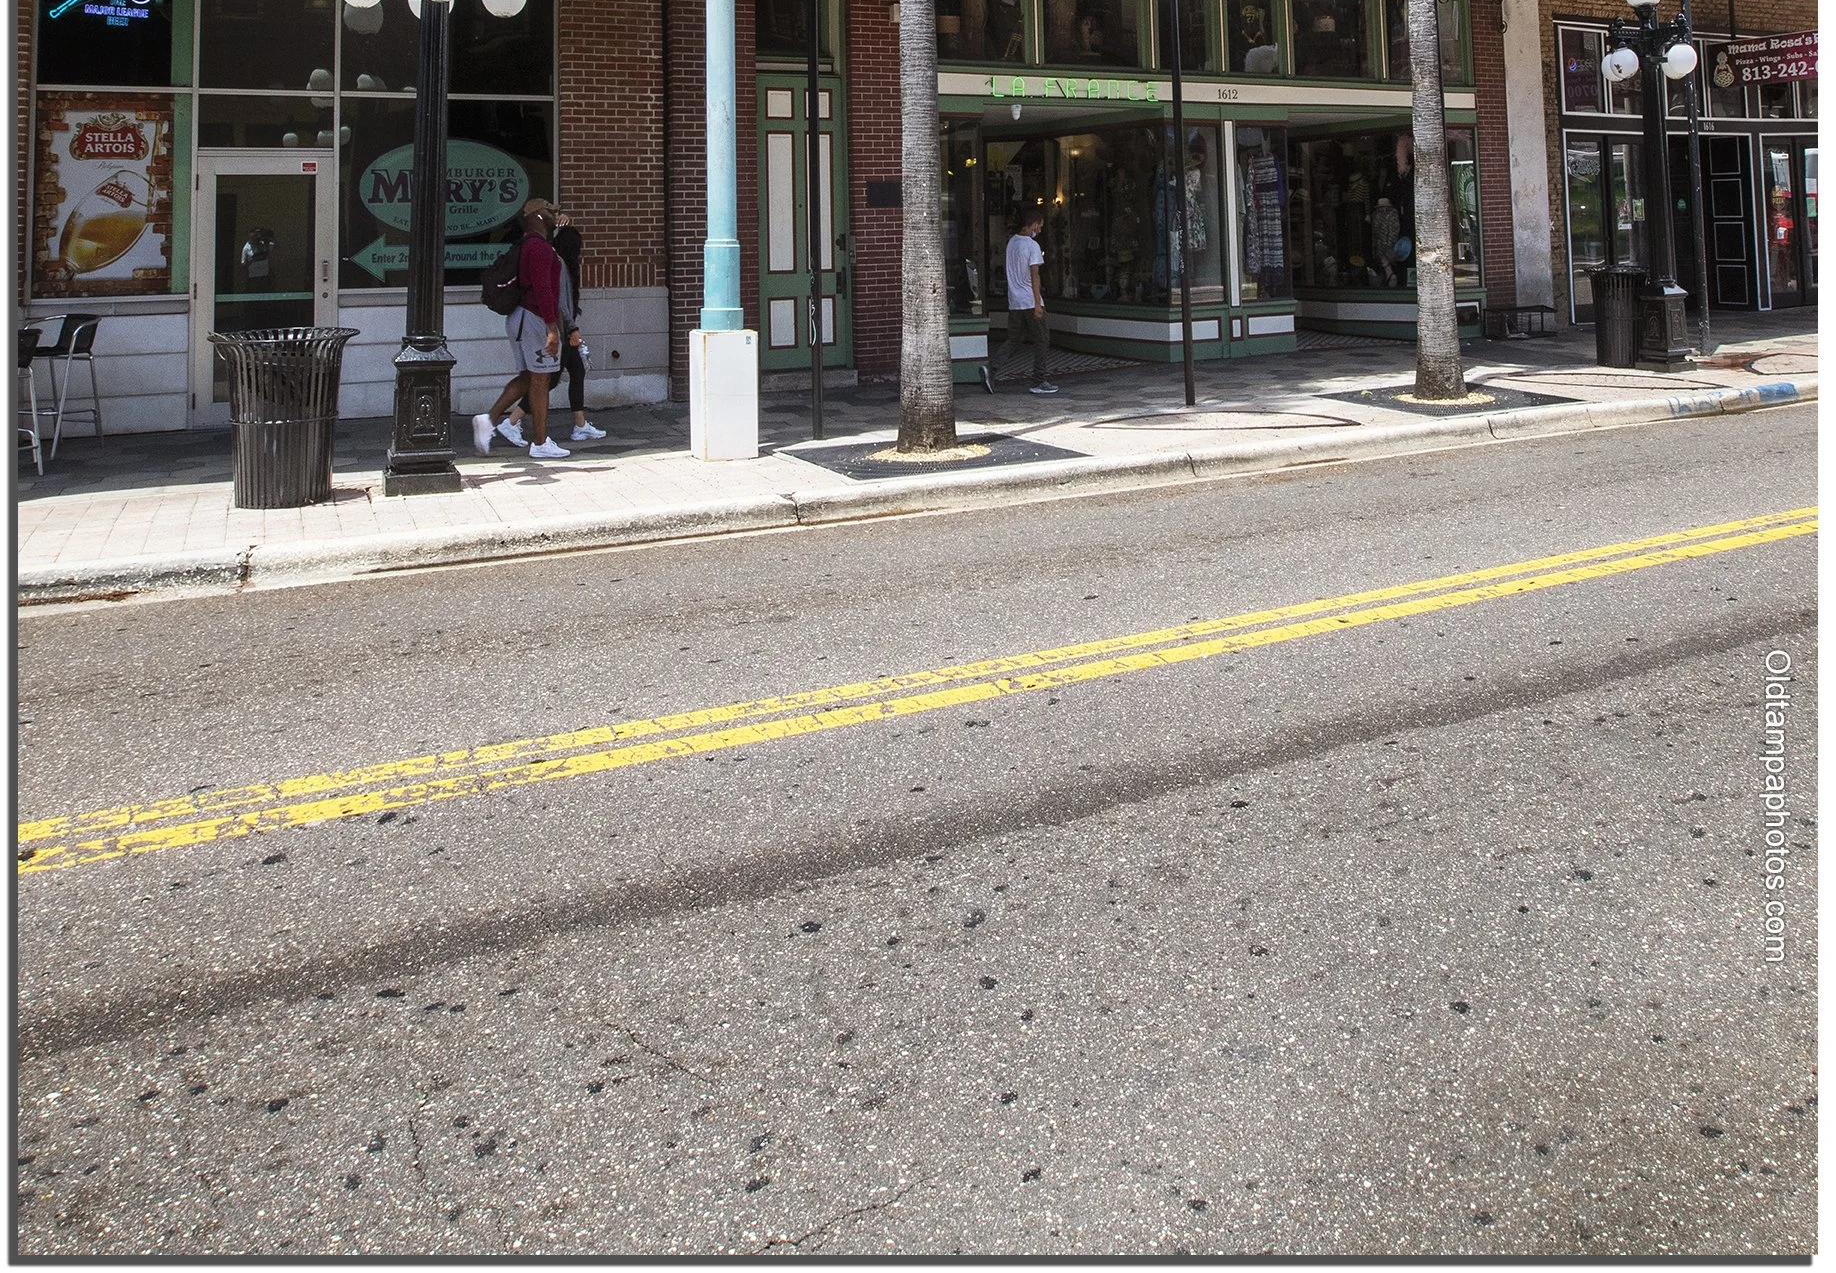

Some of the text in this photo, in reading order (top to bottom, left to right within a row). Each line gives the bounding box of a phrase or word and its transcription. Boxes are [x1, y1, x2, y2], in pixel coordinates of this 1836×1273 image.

[84, 4, 149, 19] MAJOR LEAGUE
[106, 16, 129, 27] BEER
[1727, 41, 1767, 56] Mama
[1769, 34, 1813, 50] Rosa's
[1735, 58, 1754, 66] Pizza
[1759, 55, 1781, 64] Wings
[1786, 51, 1803, 60] Subs
[991, 76, 1159, 102] LA FRANCE
[1217, 89, 1239, 100] 1612
[1703, 121, 1715, 131] 1616
[85, 132, 135, 142] STELLA
[84, 143, 135, 153] ARTOIS
[446, 168, 515, 177] MBURGER
[368, 169, 519, 203] MRY'S
[450, 206, 479, 214] Grille
[371, 253, 396, 263] Enter
[444, 250, 478, 262] Around
[480, 250, 494, 261] the
